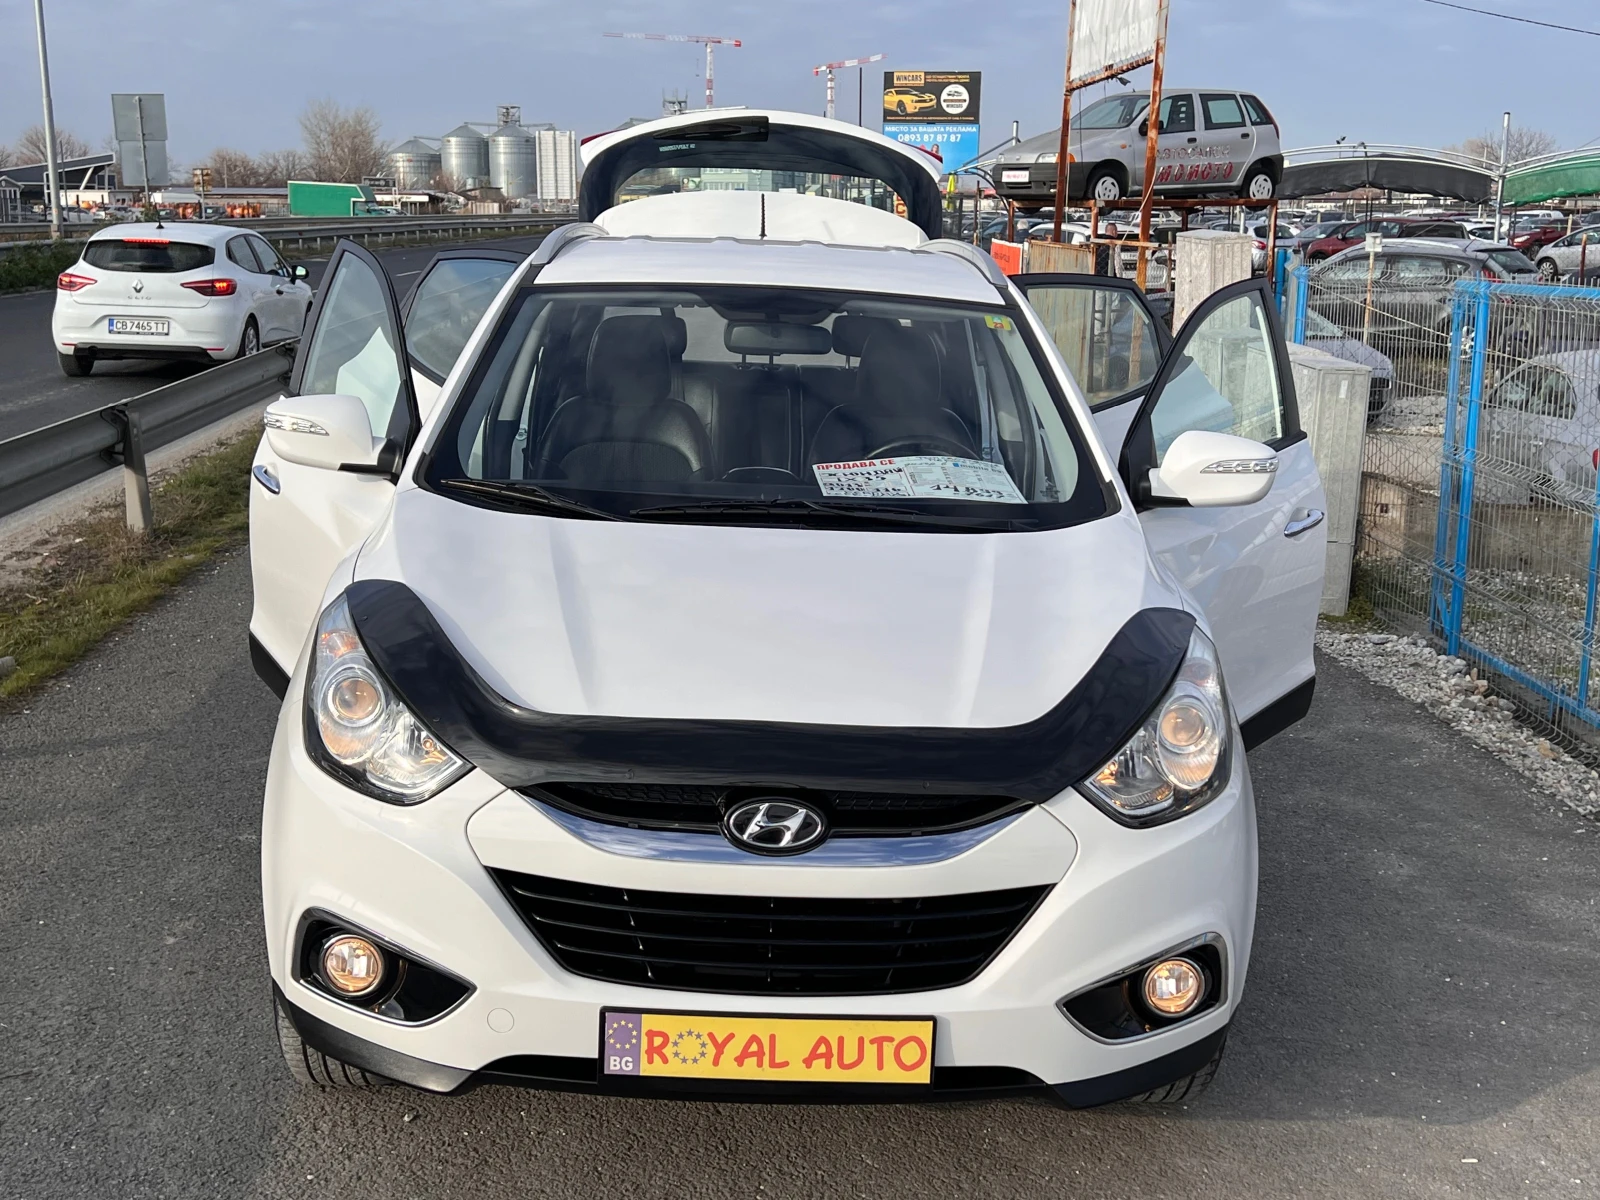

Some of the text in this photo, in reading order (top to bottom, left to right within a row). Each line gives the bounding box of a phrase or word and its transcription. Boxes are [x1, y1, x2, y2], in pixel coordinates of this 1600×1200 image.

[897, 134, 961, 142] 0893 87 87 87
[115, 321, 166, 332] CB 7465 TT
[816, 461, 877, 470] ПРОДАВА
[880, 458, 896, 466] СЕ
[644, 1029, 928, 1072] ROYAL AUTO
[609, 1056, 634, 1071] BG
